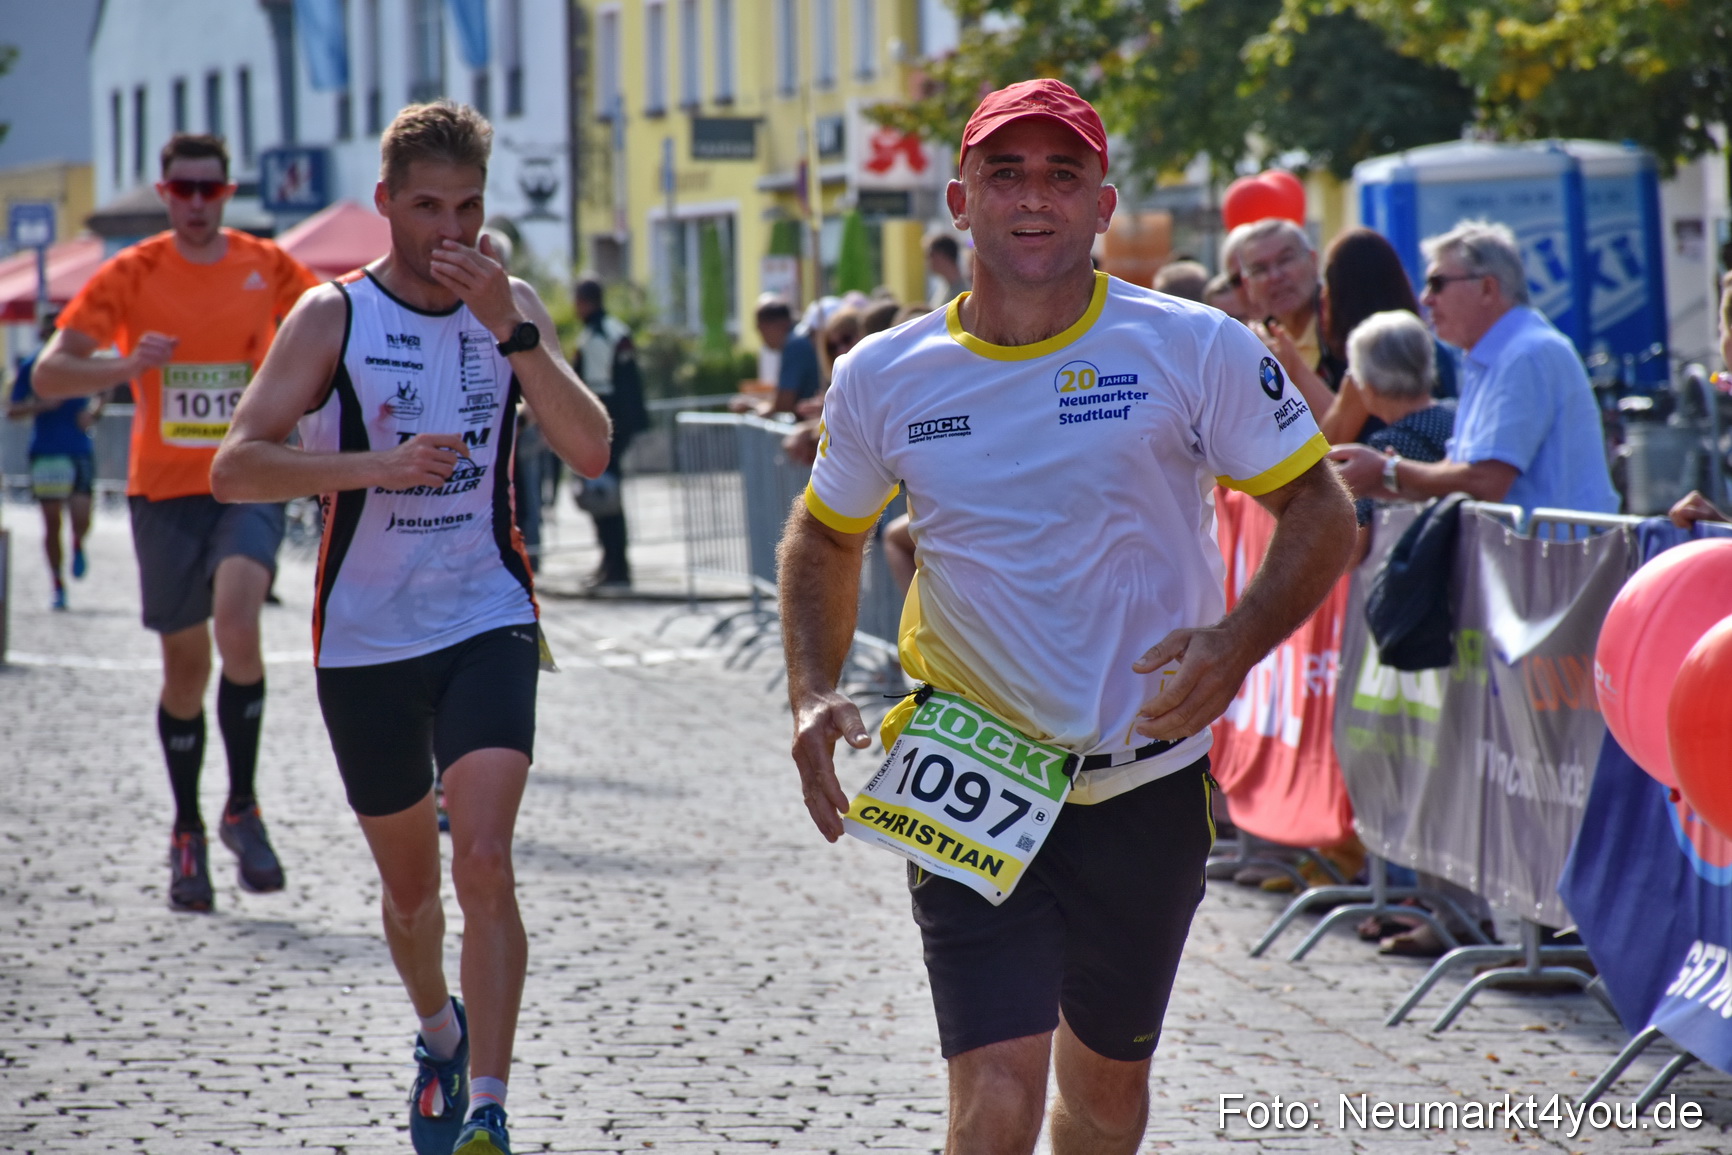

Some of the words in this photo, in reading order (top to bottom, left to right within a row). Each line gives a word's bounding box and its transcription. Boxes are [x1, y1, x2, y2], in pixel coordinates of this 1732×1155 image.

[166, 364, 249, 389] BOCK
[1059, 368, 1096, 393] 20
[1100, 374, 1135, 387] JAHRE
[1058, 389, 1149, 408] Neumarkter
[1273, 397, 1303, 424] PAFTL
[908, 415, 971, 439] BOCK
[1058, 404, 1132, 426] Stadtlauf
[1278, 404, 1309, 432] Neumarkt
[948, 430, 971, 438] concepts
[909, 697, 1064, 792] BOCK
[896, 747, 1033, 839] 1097
[1035, 810, 1046, 823] B
[859, 805, 1005, 878] CHRISTIAN
